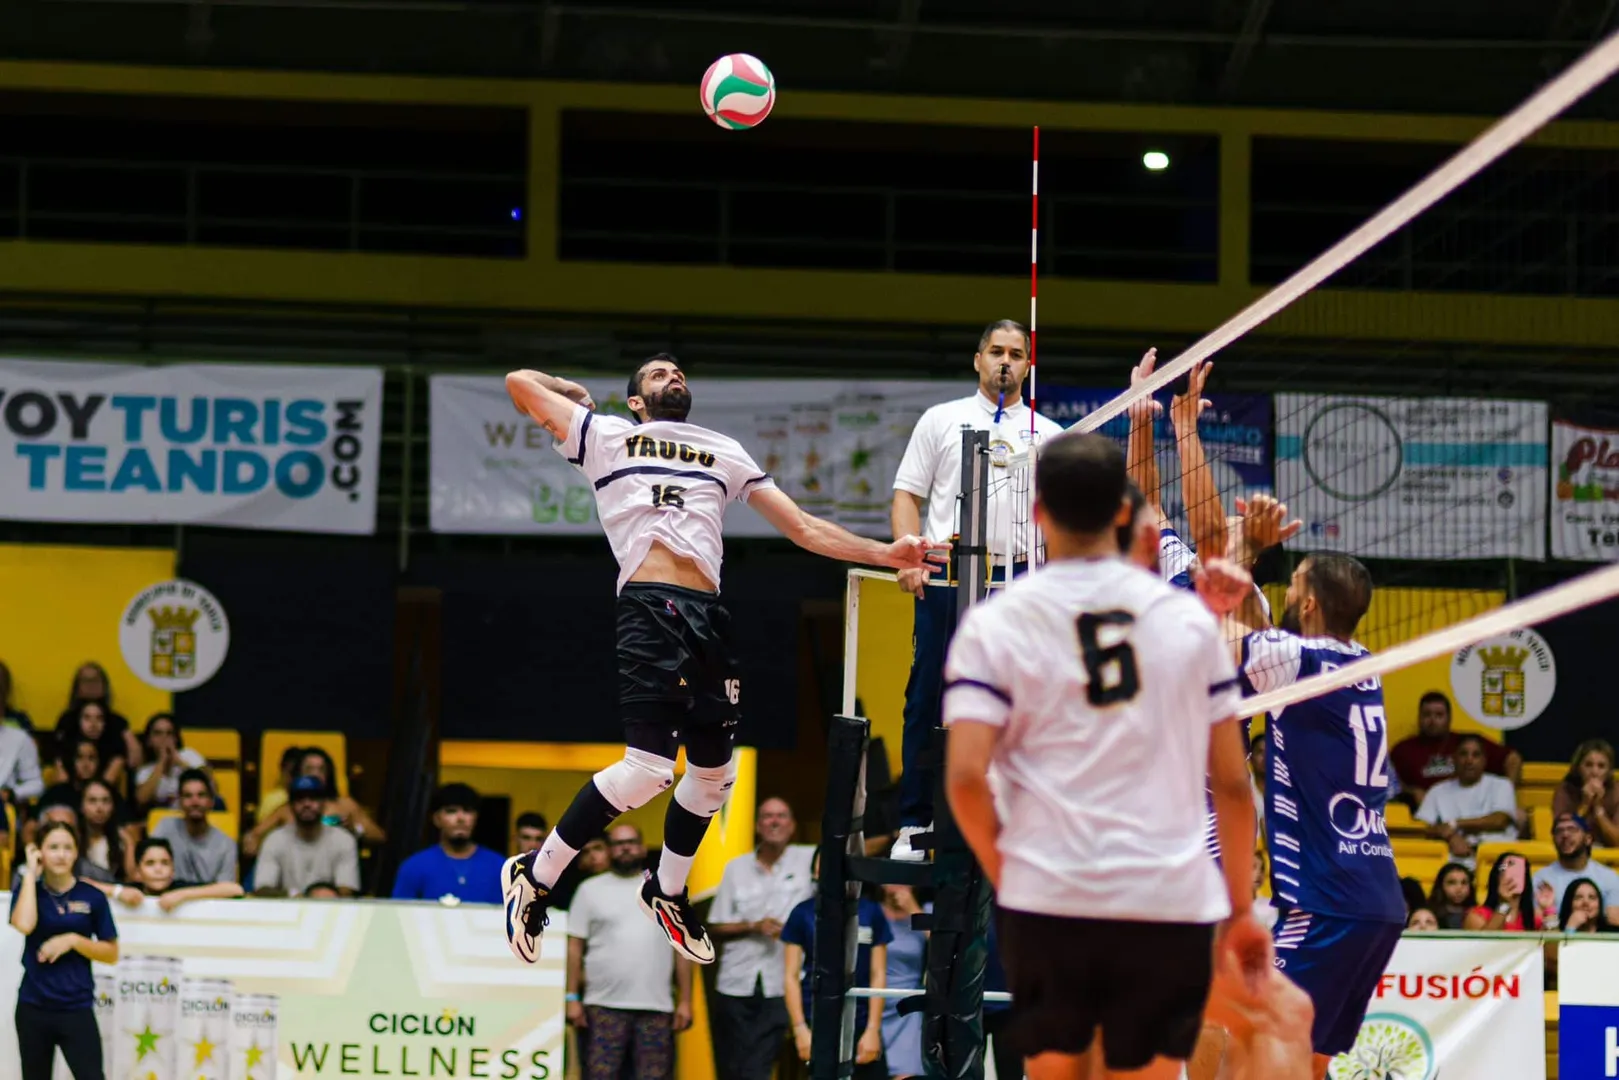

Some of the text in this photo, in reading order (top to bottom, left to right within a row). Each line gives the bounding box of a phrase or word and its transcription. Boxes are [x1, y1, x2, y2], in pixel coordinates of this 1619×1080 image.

[0, 390, 106, 440] OY
[16, 444, 326, 499] TEANDO
[331, 400, 364, 502] .COM
[651, 484, 688, 509] 16
[1075, 609, 1141, 706] 6
[724, 678, 740, 705] 16
[1348, 704, 1389, 787] 12
[1338, 840, 1358, 855] Air
[1376, 965, 1519, 1000] FUSIÓN
[290, 1042, 550, 1080] WELLNESS
